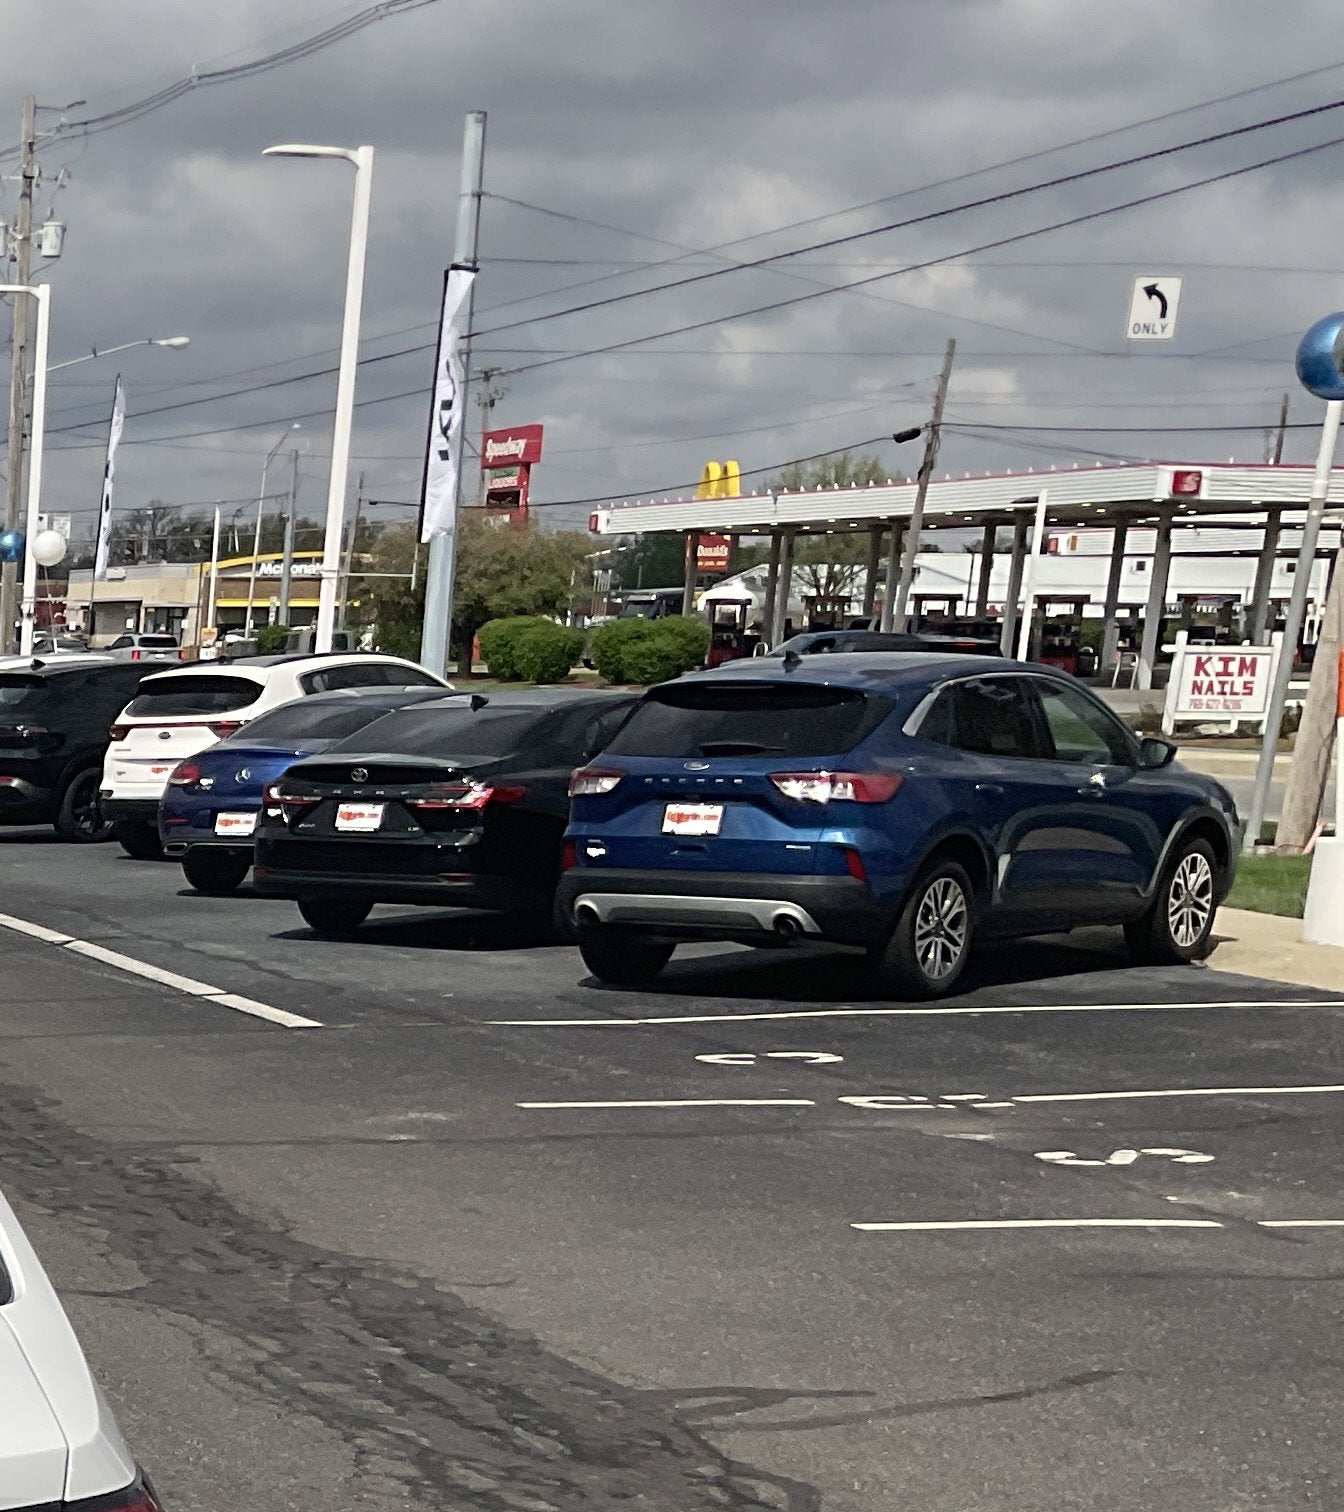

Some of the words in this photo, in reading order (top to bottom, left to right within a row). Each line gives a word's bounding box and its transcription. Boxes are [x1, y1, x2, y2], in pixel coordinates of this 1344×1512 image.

[1132, 322, 1169, 335] ONLY
[1194, 656, 1258, 677] KIM
[1191, 680, 1255, 696] NAILS
